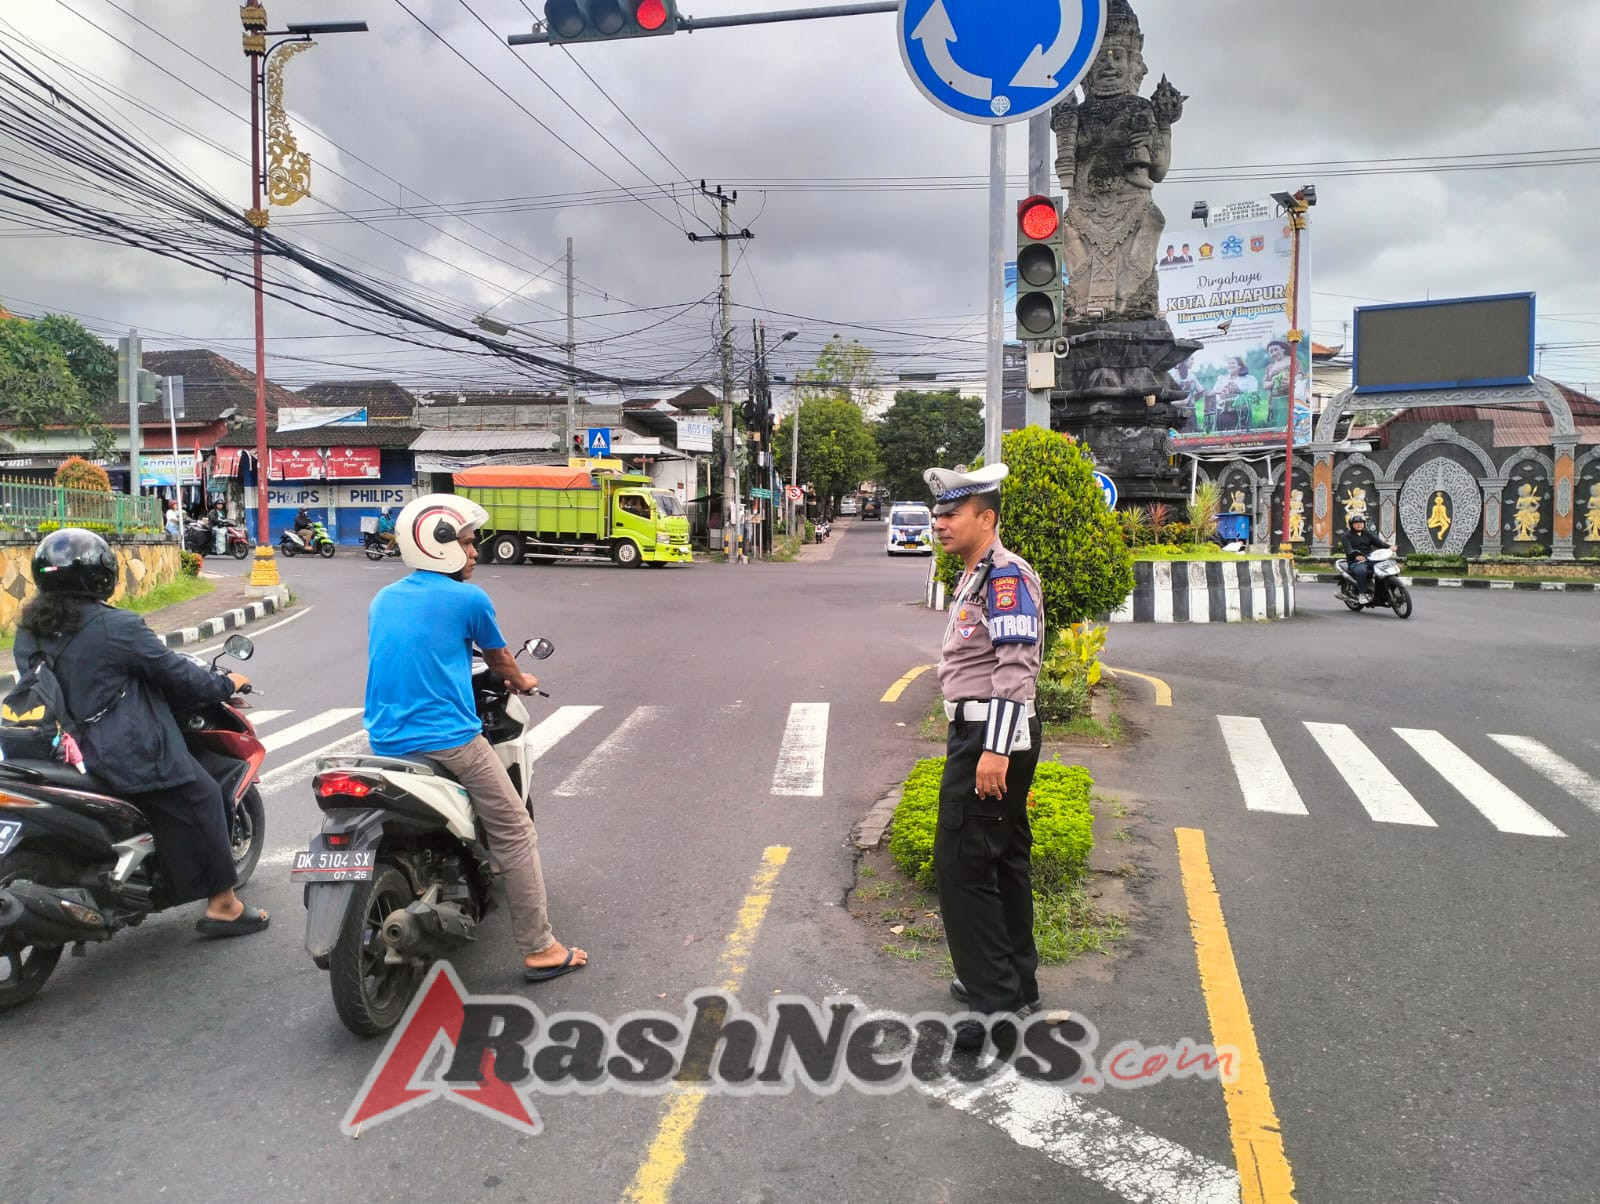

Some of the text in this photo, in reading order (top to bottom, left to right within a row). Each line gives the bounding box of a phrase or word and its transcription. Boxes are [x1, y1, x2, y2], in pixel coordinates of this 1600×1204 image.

[1197, 272, 1261, 291] Dirgahayu
[1167, 294, 1206, 311] KOTA
[1178, 303, 1287, 324] Harmony to Happiness
[268, 490, 319, 503] PHIPS
[350, 489, 404, 503] PHILIPS
[989, 615, 1038, 640] ATROLI
[297, 852, 371, 868] DK 5104 SX
